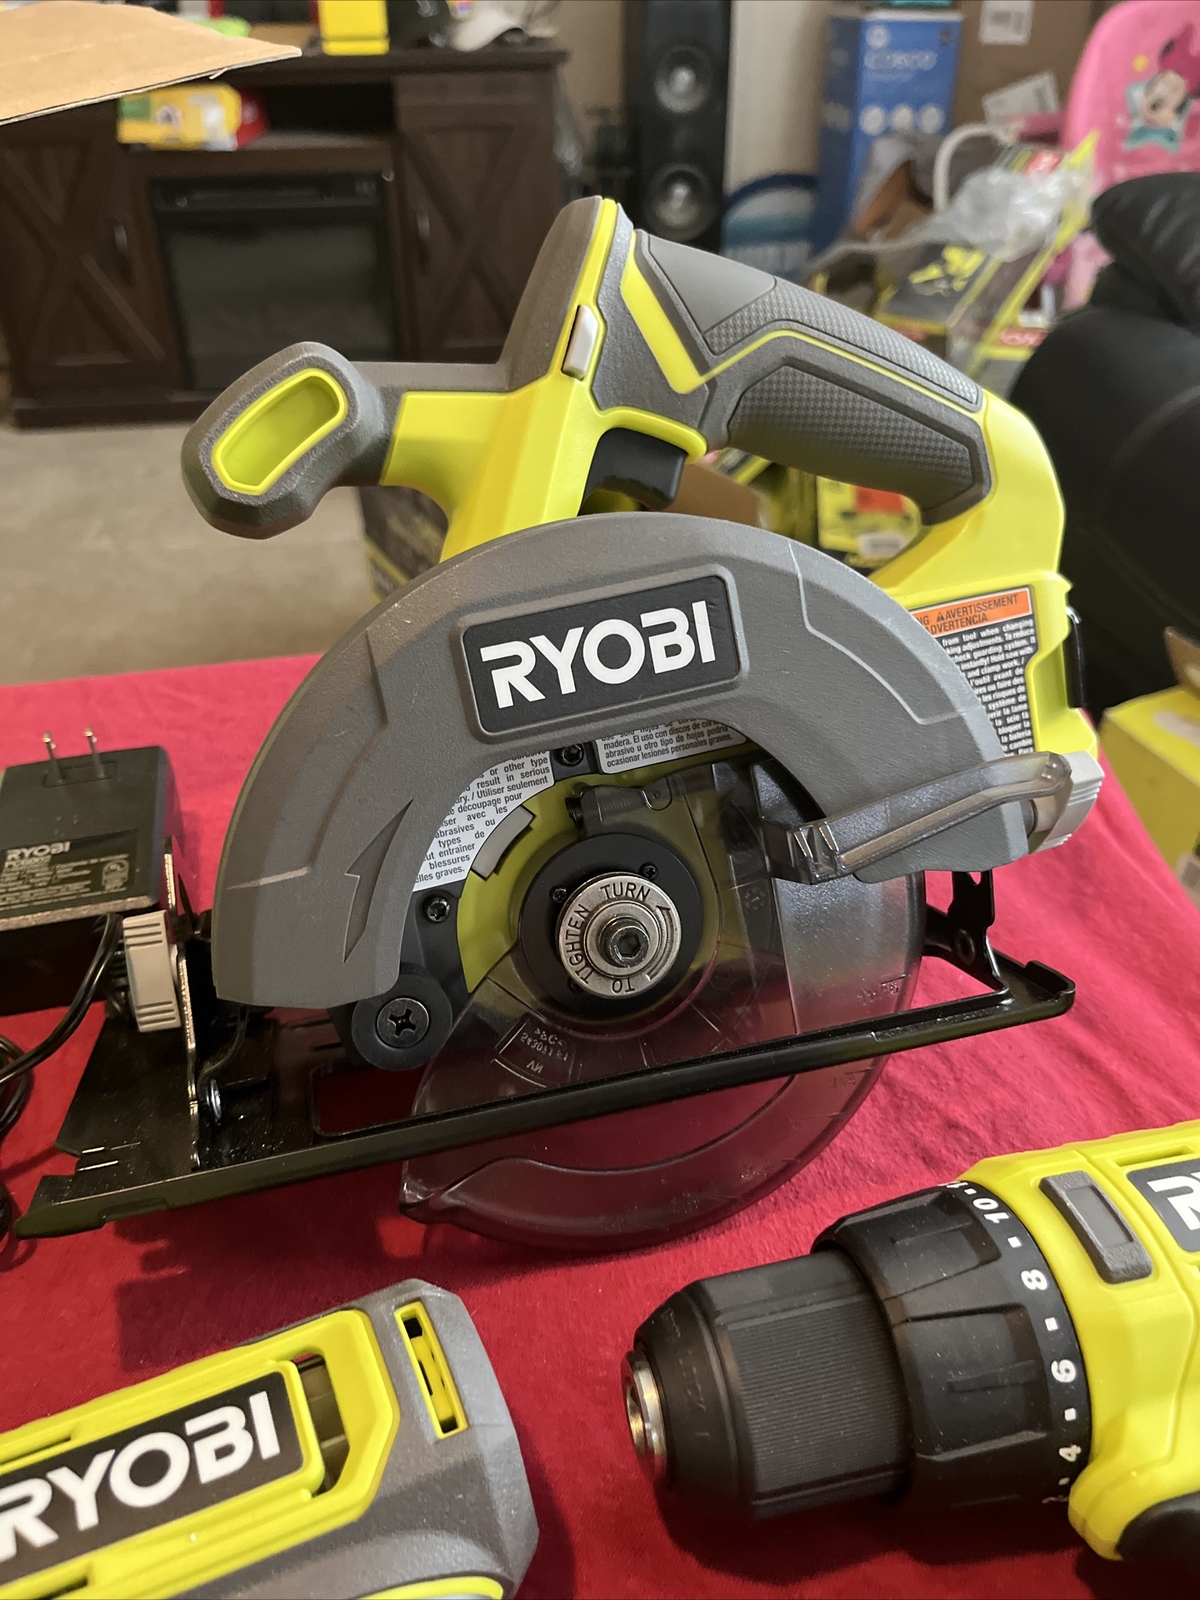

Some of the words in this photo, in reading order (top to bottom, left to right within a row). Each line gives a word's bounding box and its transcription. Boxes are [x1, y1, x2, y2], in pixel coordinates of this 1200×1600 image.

[945, 594, 1019, 622] AVERTISSEMENT
[942, 637, 959, 647] from
[962, 632, 977, 642] tool
[980, 627, 999, 638] when
[1002, 618, 1034, 632] changing
[962, 636, 1004, 652] adjustments.
[1004, 632, 1012, 641] To
[1013, 628, 1034, 638] reduce
[480, 600, 716, 709] RYOBI
[972, 645, 1003, 659] guarding
[990, 653, 1005, 663] Hold
[1005, 650, 1018, 659] saw
[967, 668, 980, 679] and
[981, 664, 1001, 675] clamp
[993, 669, 1013, 681] avant
[1015, 667, 1024, 676] de
[982, 694, 992, 702] les
[992, 688, 1016, 699] risques
[1017, 685, 1025, 693] de
[987, 684, 996, 692] ou
[996, 680, 1012, 689] faire
[1012, 677, 1024, 685] des
[1018, 694, 1027, 702] de
[1003, 707, 1010, 716] la
[1011, 703, 1028, 713] lame
[995, 719, 1002, 727] la
[1006, 715, 1020, 724] scie
[998, 723, 1022, 735] bloquer
[1023, 720, 1031, 728] la
[603, 738, 633, 751] madera.
[633, 734, 641, 743] El
[641, 733, 654, 742] uso
[654, 730, 668, 739] con
[669, 725, 691, 736] discos
[691, 723, 701, 732] de
[605, 746, 635, 759] abrasivo
[643, 741, 659, 751] otro
[660, 737, 674, 747] tipo
[675, 733, 685, 742] de
[686, 729, 705, 740] hojas
[1001, 735, 1008, 743] la
[606, 754, 641, 768] ocasionar
[641, 746, 670, 760] lesiones
[671, 739, 708, 755] personales
[708, 733, 733, 746] graves.
[489, 768, 499, 776] or
[503, 762, 525, 773] other
[530, 756, 548, 768] type
[476, 776, 501, 789] result
[506, 774, 515, 783] in
[520, 767, 550, 779] serious
[476, 786, 505, 799] Utiliser
[507, 776, 548, 792] seulement
[457, 797, 502, 813] découpage
[504, 792, 523, 804] pour
[466, 811, 487, 822] avec
[495, 805, 508, 814] les
[434, 823, 475, 839] abrasives
[485, 818, 496, 827] ou
[438, 837, 462, 849] types
[474, 831, 485, 840] de
[6, 841, 71, 861] RYOBI
[438, 843, 476, 858] entraîner
[429, 854, 471, 870] blessures
[435, 866, 465, 880] graves.
[600, 882, 651, 901] TURN
[565, 903, 595, 985] TIGHTEN
[611, 977, 635, 994] TO
[972, 1197, 1011, 1225] 10
[1020, 1268, 1048, 1291] 8
[1051, 1358, 1077, 1384] 6
[1058, 1443, 1083, 1463] 4
